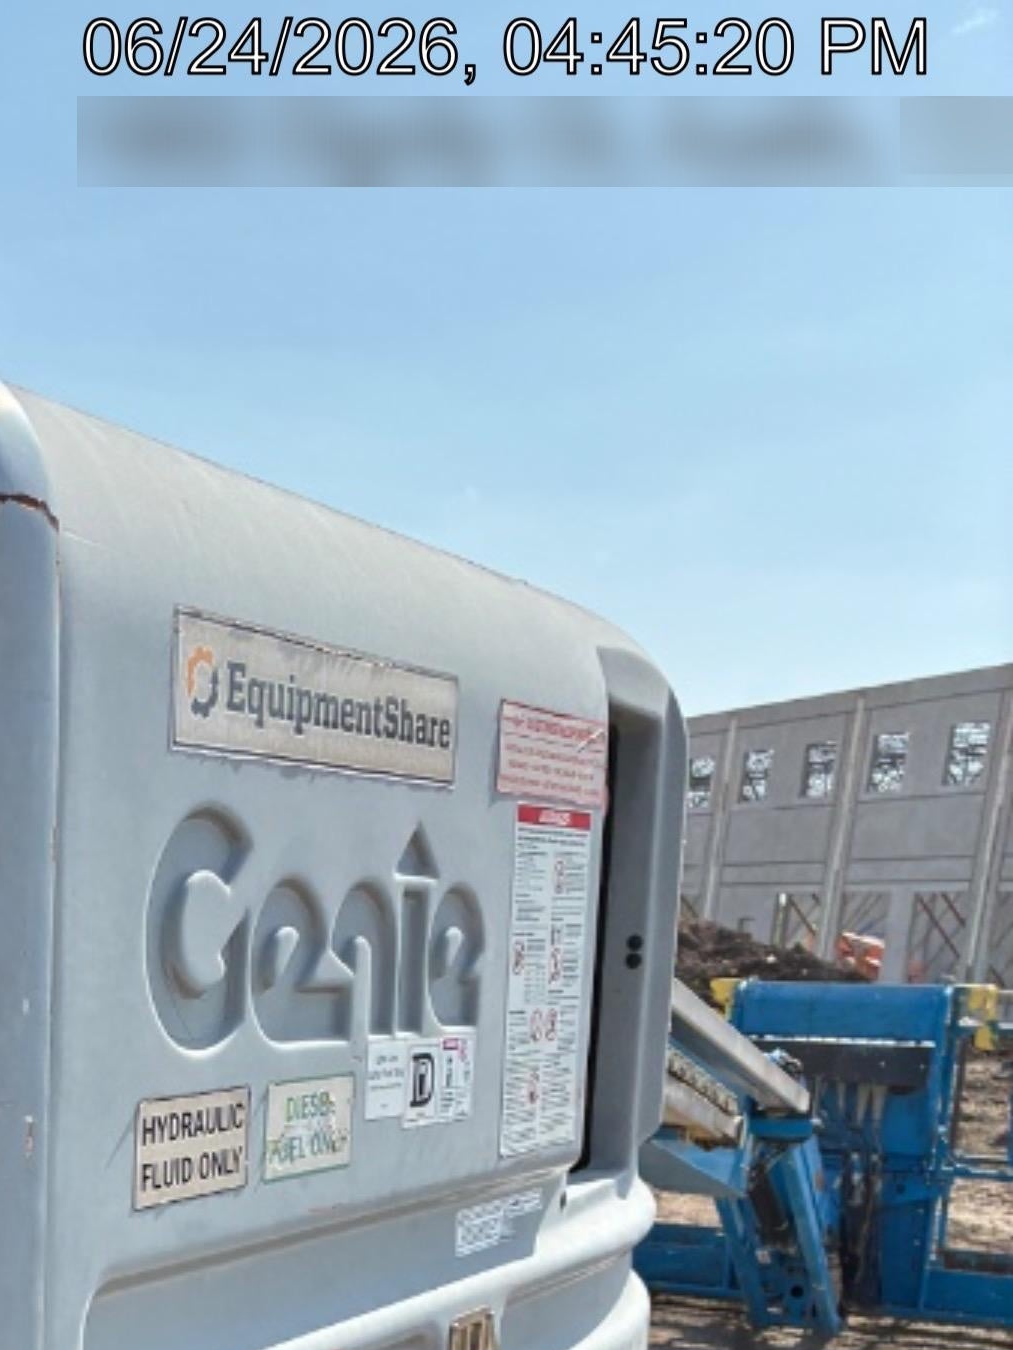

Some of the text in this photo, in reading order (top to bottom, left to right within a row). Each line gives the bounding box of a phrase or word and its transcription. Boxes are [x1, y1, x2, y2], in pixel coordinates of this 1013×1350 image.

[226, 661, 451, 749] EquipmentShare
[143, 800, 485, 1058] Genie
[142, 1102, 245, 1147] HYDRAULIC
[141, 1145, 243, 1192] FLUID ONLY
